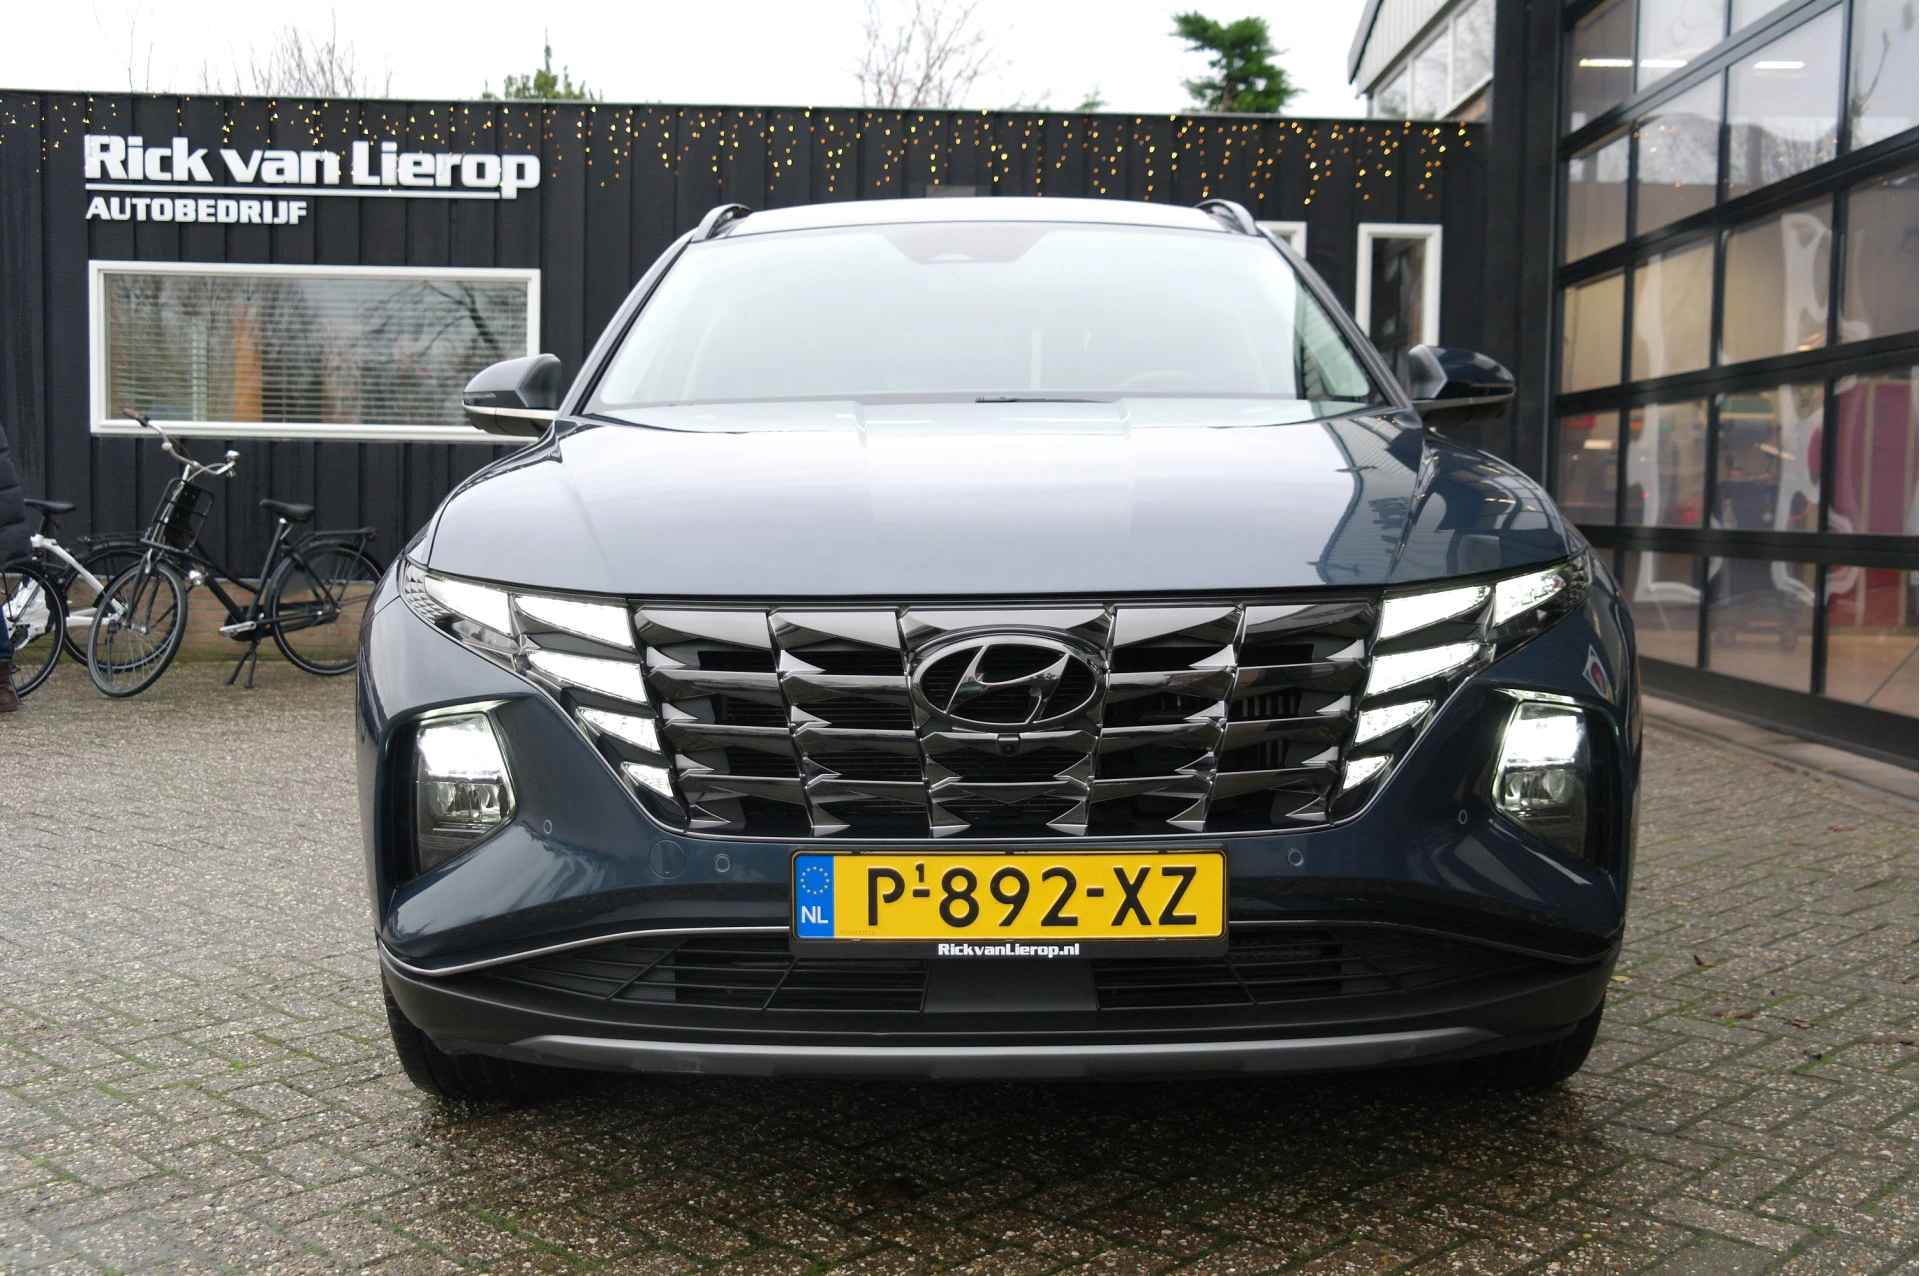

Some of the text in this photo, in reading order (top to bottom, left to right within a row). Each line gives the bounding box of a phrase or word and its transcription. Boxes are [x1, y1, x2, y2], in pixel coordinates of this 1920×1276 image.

[84, 134, 541, 199] Rick van Lierop
[85, 196, 307, 224] AUTOBEDRIJF
[801, 905, 829, 924] NL
[938, 943, 1080, 958] RickvanLierop.nl
